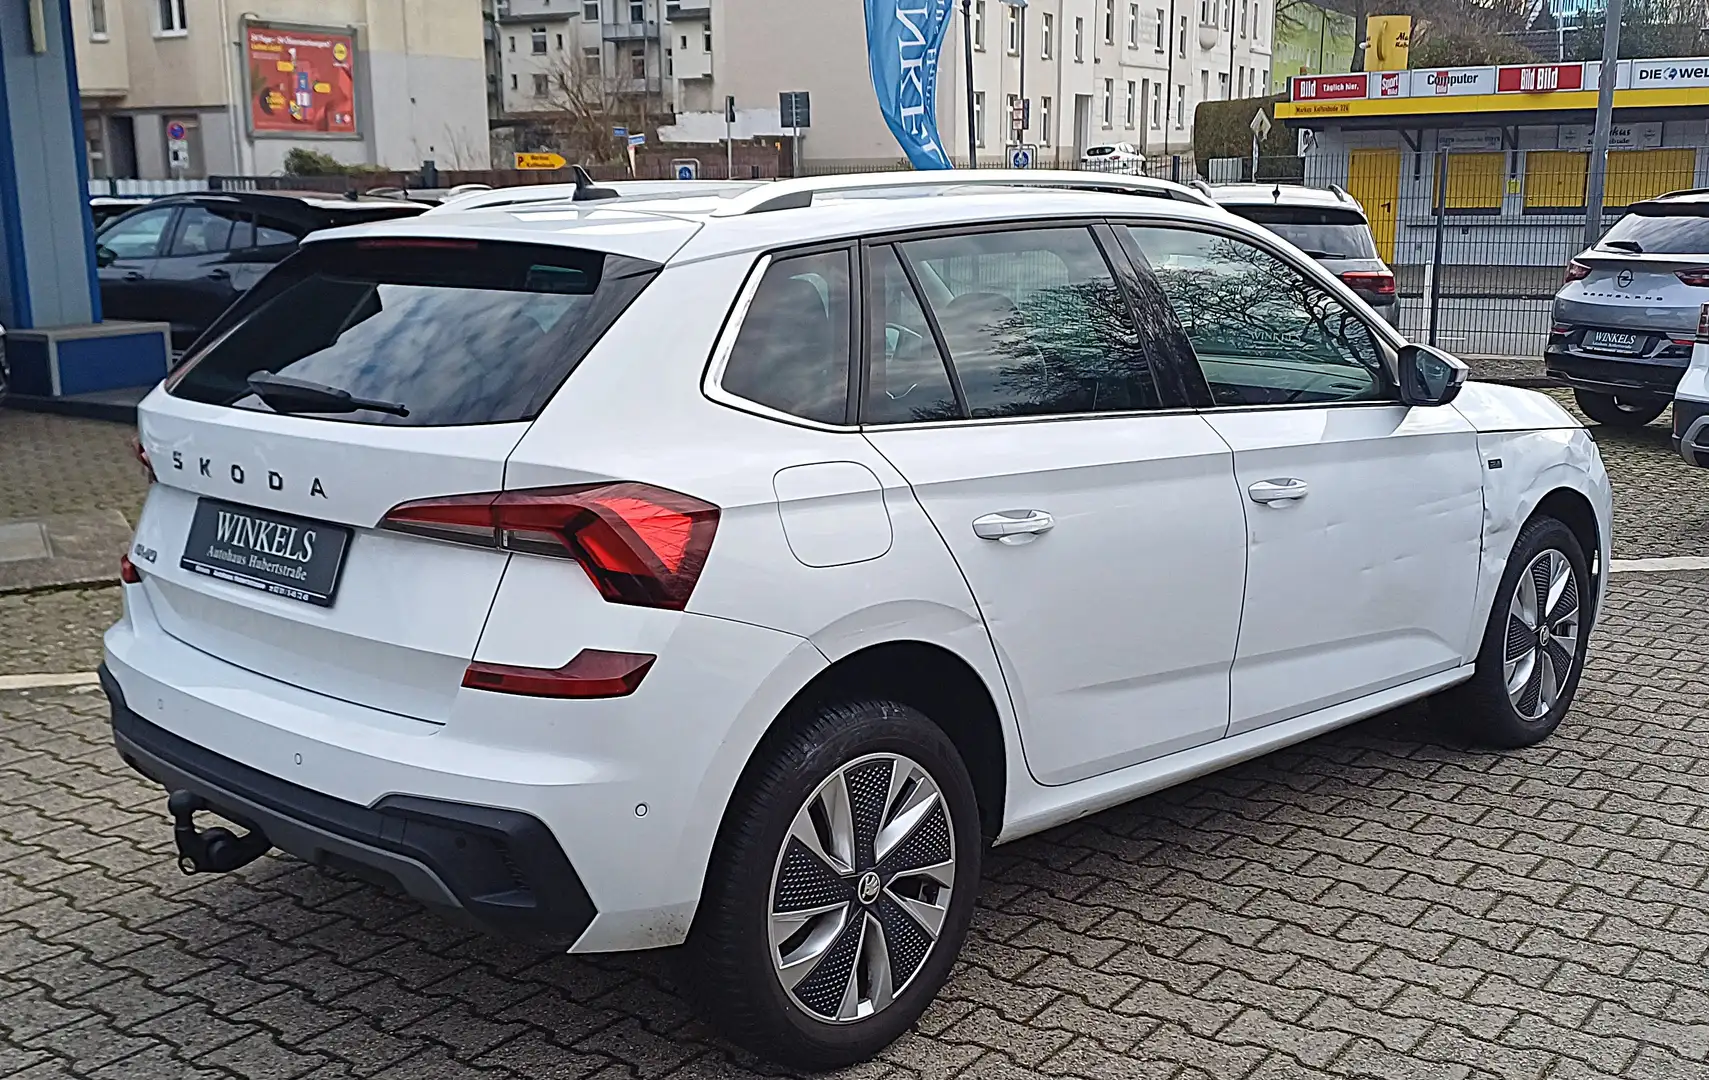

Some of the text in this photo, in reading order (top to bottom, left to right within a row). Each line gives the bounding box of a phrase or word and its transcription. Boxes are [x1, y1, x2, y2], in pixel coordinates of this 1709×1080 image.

[1427, 73, 1478, 87] Computer
[1520, 67, 1558, 90] Bild Bild
[1639, 69, 1662, 80] DIE
[1300, 80, 1316, 98] Bild
[1595, 331, 1636, 345] WINKELS
[216, 511, 316, 563] WINKELS
[206, 545, 246, 565] Autohaus
[249, 556, 307, 581] Hubertstraße
